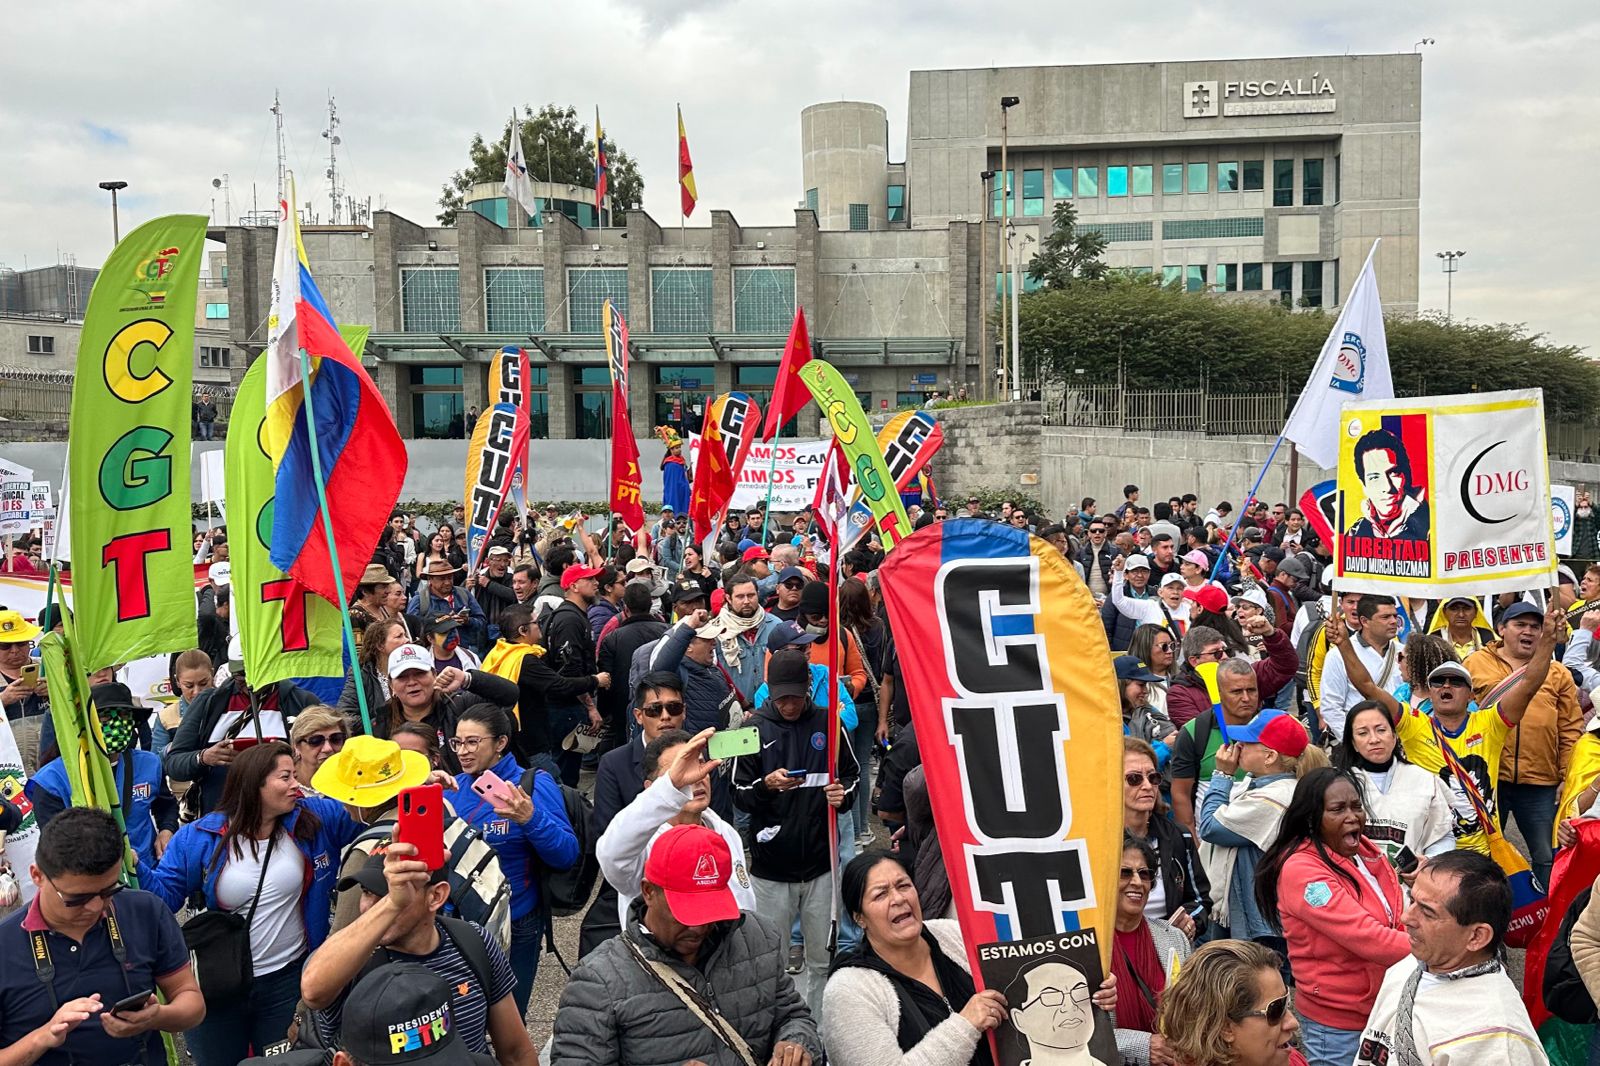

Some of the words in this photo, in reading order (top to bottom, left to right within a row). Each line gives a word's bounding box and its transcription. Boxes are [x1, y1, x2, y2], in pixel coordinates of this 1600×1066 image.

[1224, 72, 1336, 98] FISCALÍA
[99, 318, 174, 622] CGT
[472, 411, 517, 529] CUT
[1475, 469, 1530, 497] DMG
[11, 500, 22, 510] ES
[1345, 536, 1429, 561] LIBERTAD
[1444, 542, 1546, 571] PRESENTE
[1346, 556, 1368, 572] DAVID
[1368, 558, 1395, 574] MURCIA
[1396, 555, 1430, 577] GUZMÁN
[937, 558, 1095, 941] CUT
[108, 917, 120, 940] Nikon
[34, 935, 46, 960] Nikon
[980, 940, 1056, 961] ESTAMOS
[1059, 932, 1096, 950] CON
[388, 1001, 450, 1035] PRESIDENTE
[389, 1010, 451, 1055] PETRO
